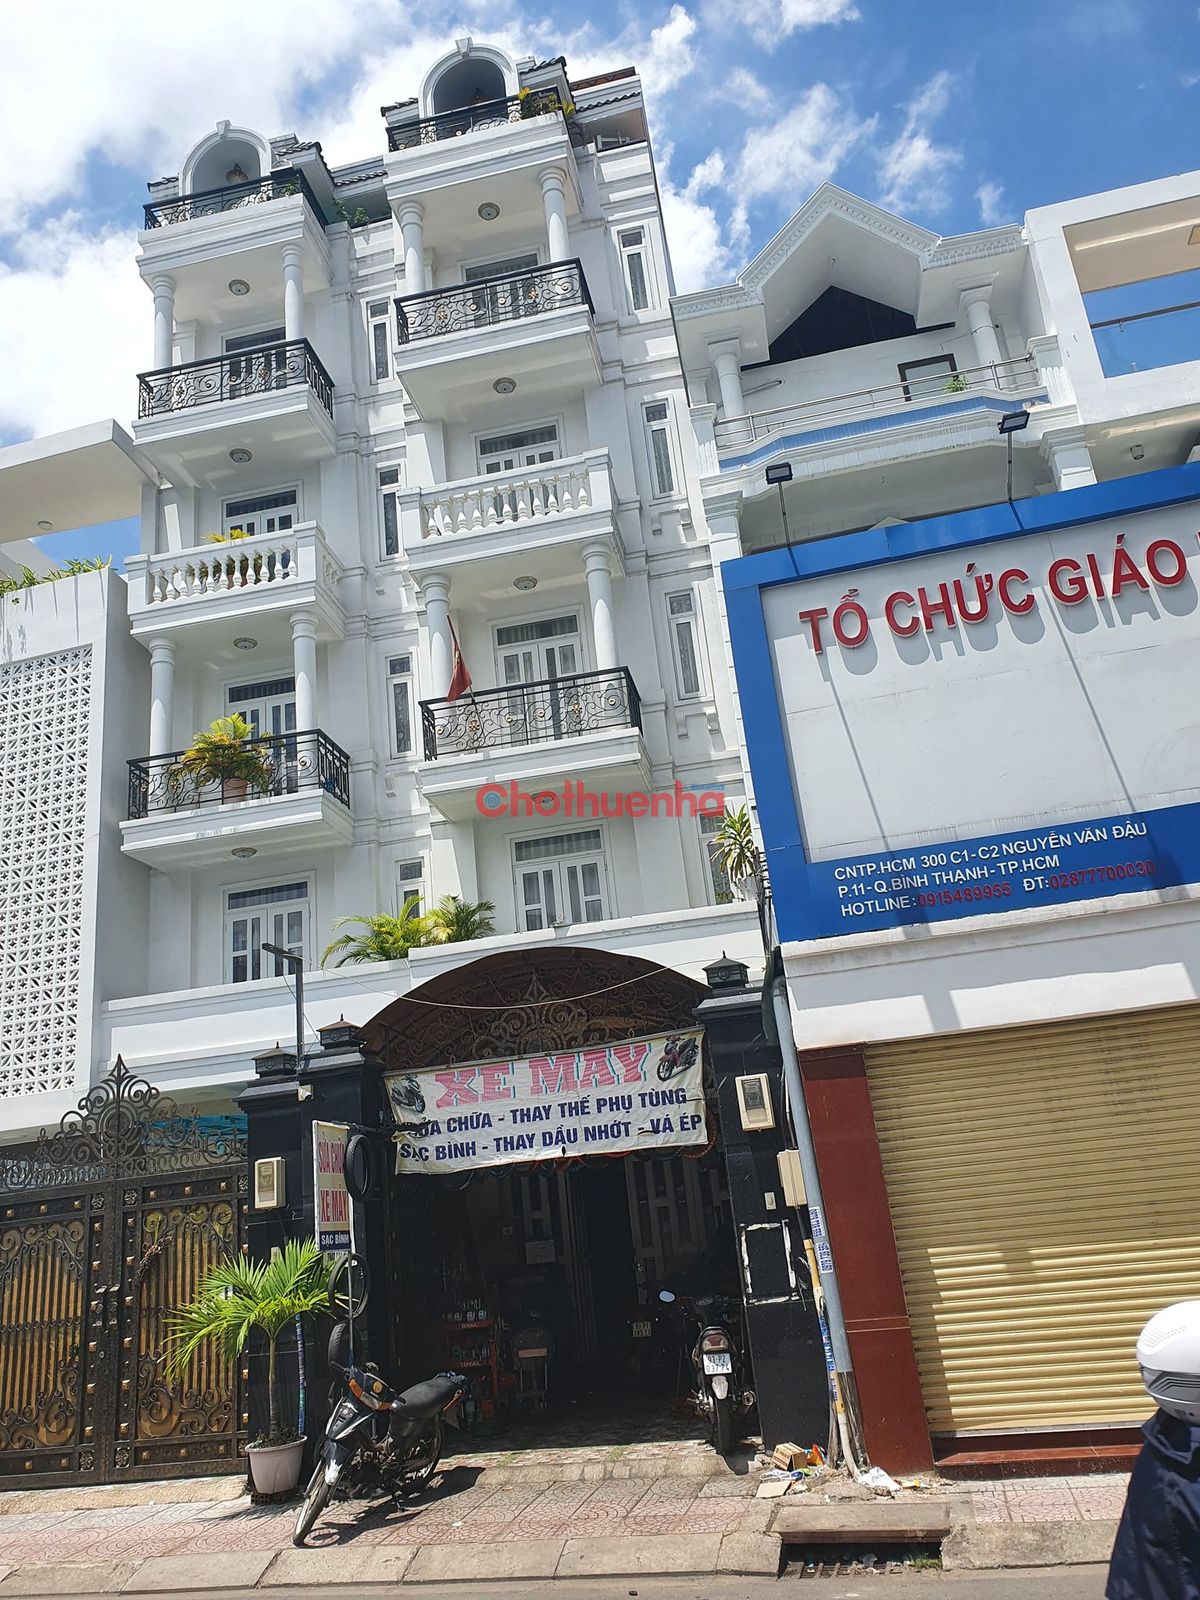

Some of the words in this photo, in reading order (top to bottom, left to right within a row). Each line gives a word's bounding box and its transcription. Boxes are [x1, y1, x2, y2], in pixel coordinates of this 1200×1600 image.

[799, 588, 870, 655] TỔ
[884, 563, 1036, 638] CHỨC
[1047, 533, 1188, 608] GIÁO
[834, 857, 916, 881] CNTP.HCM
[921, 852, 947, 868] 300
[1002, 831, 1072, 857] NGUYỄN
[1075, 827, 1108, 846] VĂN
[1112, 821, 1148, 840] ĐẬU
[435, 1062, 517, 1108] XE
[528, 1042, 652, 1096] MAY
[435, 1141, 477, 1161] BÌNH
[493, 1133, 536, 1154] THAY
[541, 1124, 579, 1146] DẦU
[583, 1118, 633, 1142] NHỚT
[649, 1115, 675, 1134] VÁ
[679, 1113, 703, 1132] ÉP
[446, 1110, 493, 1134] CHỮA
[509, 1104, 552, 1125] THAY
[557, 1094, 592, 1116] THẾ
[596, 1094, 634, 1114] PHỤ
[637, 1087, 688, 1107] TÙNG
[321, 1189, 331, 1222] XE
